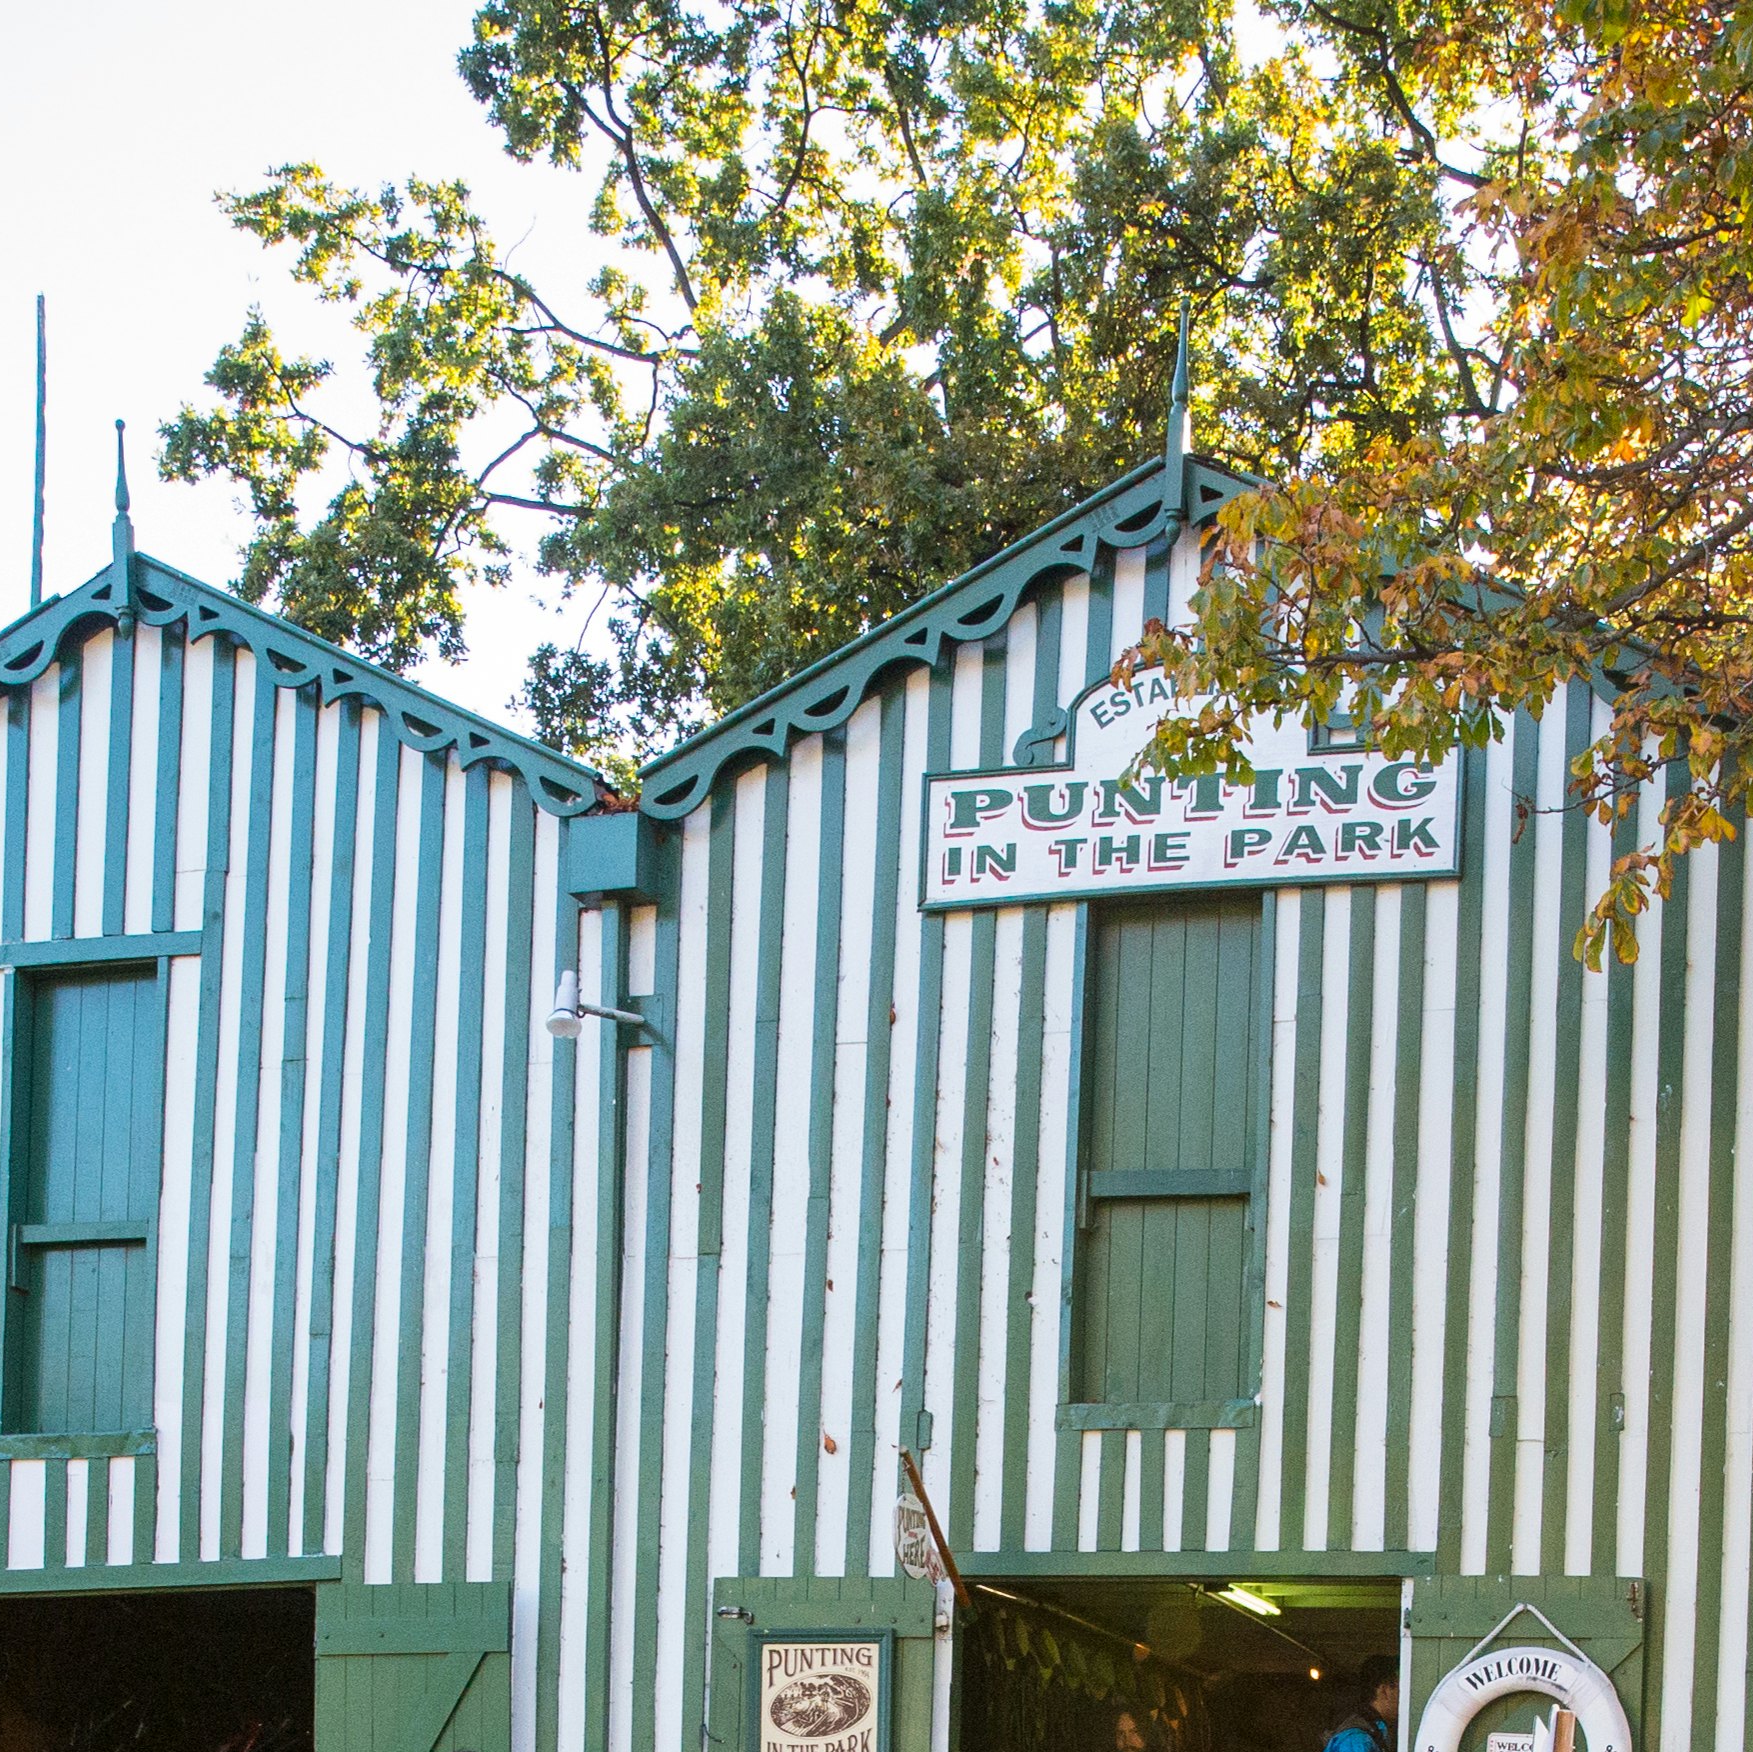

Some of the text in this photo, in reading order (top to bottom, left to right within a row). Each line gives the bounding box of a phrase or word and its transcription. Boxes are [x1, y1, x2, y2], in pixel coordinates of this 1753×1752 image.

[945, 762, 1438, 837] PUNTING
[943, 817, 1440, 885] IN THE PARK
[767, 1647, 873, 1688] PUNTING
[1464, 1656, 1563, 1691] WELCOME
